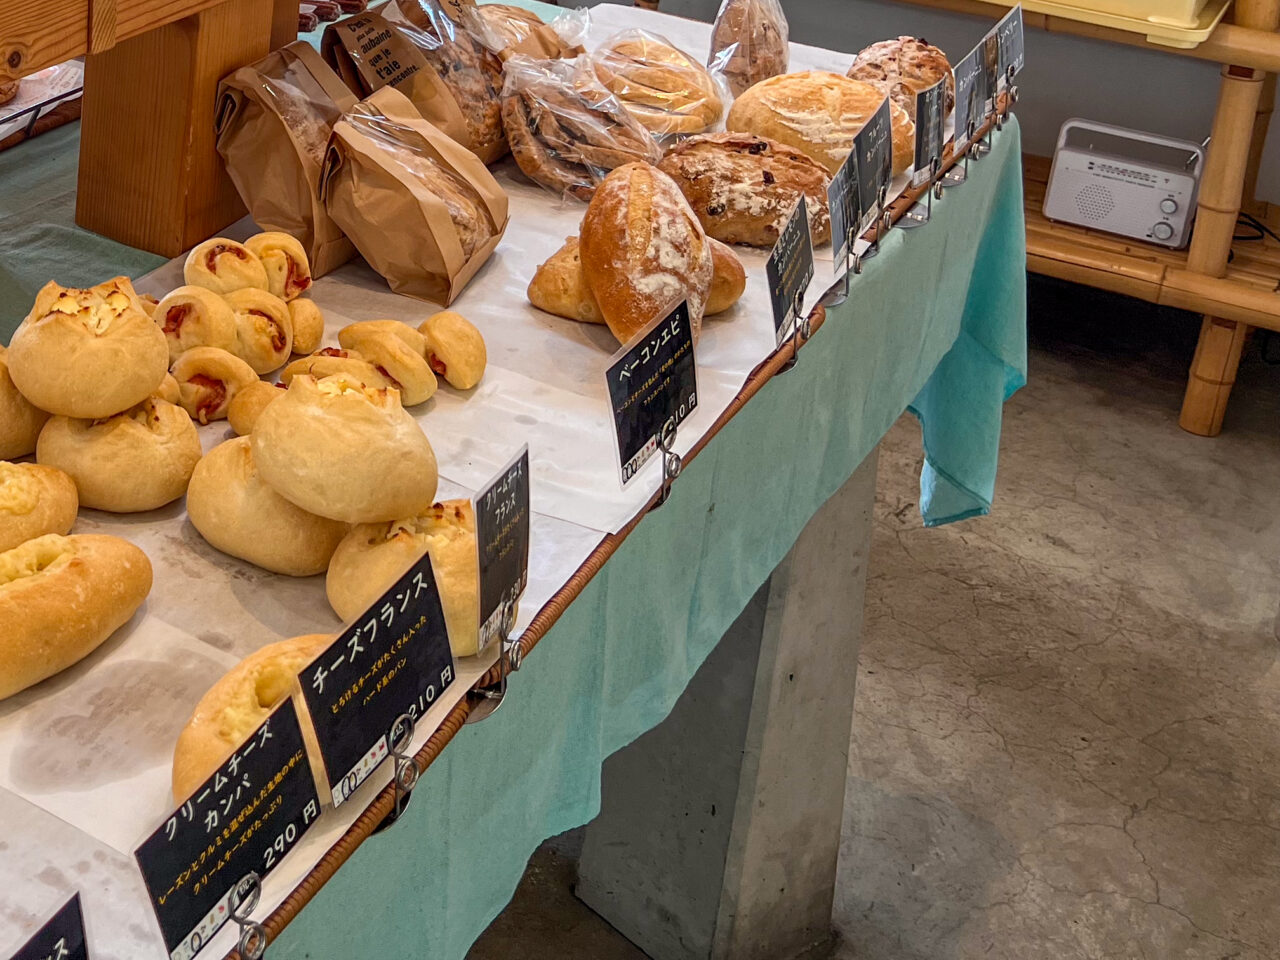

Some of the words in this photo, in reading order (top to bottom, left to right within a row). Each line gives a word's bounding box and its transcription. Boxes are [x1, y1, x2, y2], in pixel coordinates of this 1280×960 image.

[360, 29, 392, 54] aubaine
[368, 53, 383, 67] que
[381, 48, 392, 59] je
[375, 60, 401, 80] t'aie
[619, 314, 681, 381] ベーコンエピ
[688, 392, 696, 409] 円
[486, 461, 522, 511] クリームチーズ
[495, 493, 516, 525] フランス
[312, 572, 428, 694] チーズフランス
[332, 615, 427, 714] とろけるチーズがたくさん入った
[363, 657, 407, 706] ハード系のパン
[408, 685, 435, 720] 210
[440, 665, 452, 688] 円
[166, 718, 273, 841] クリームチーズ
[204, 773, 251, 833] カンパ
[158, 749, 304, 905] レーズンとクルミを混ぜ込んだ生地の中に
[193, 794, 283, 895] クリームチーズがたっぷり
[263, 823, 296, 869] 290
[303, 798, 317, 824] 円
